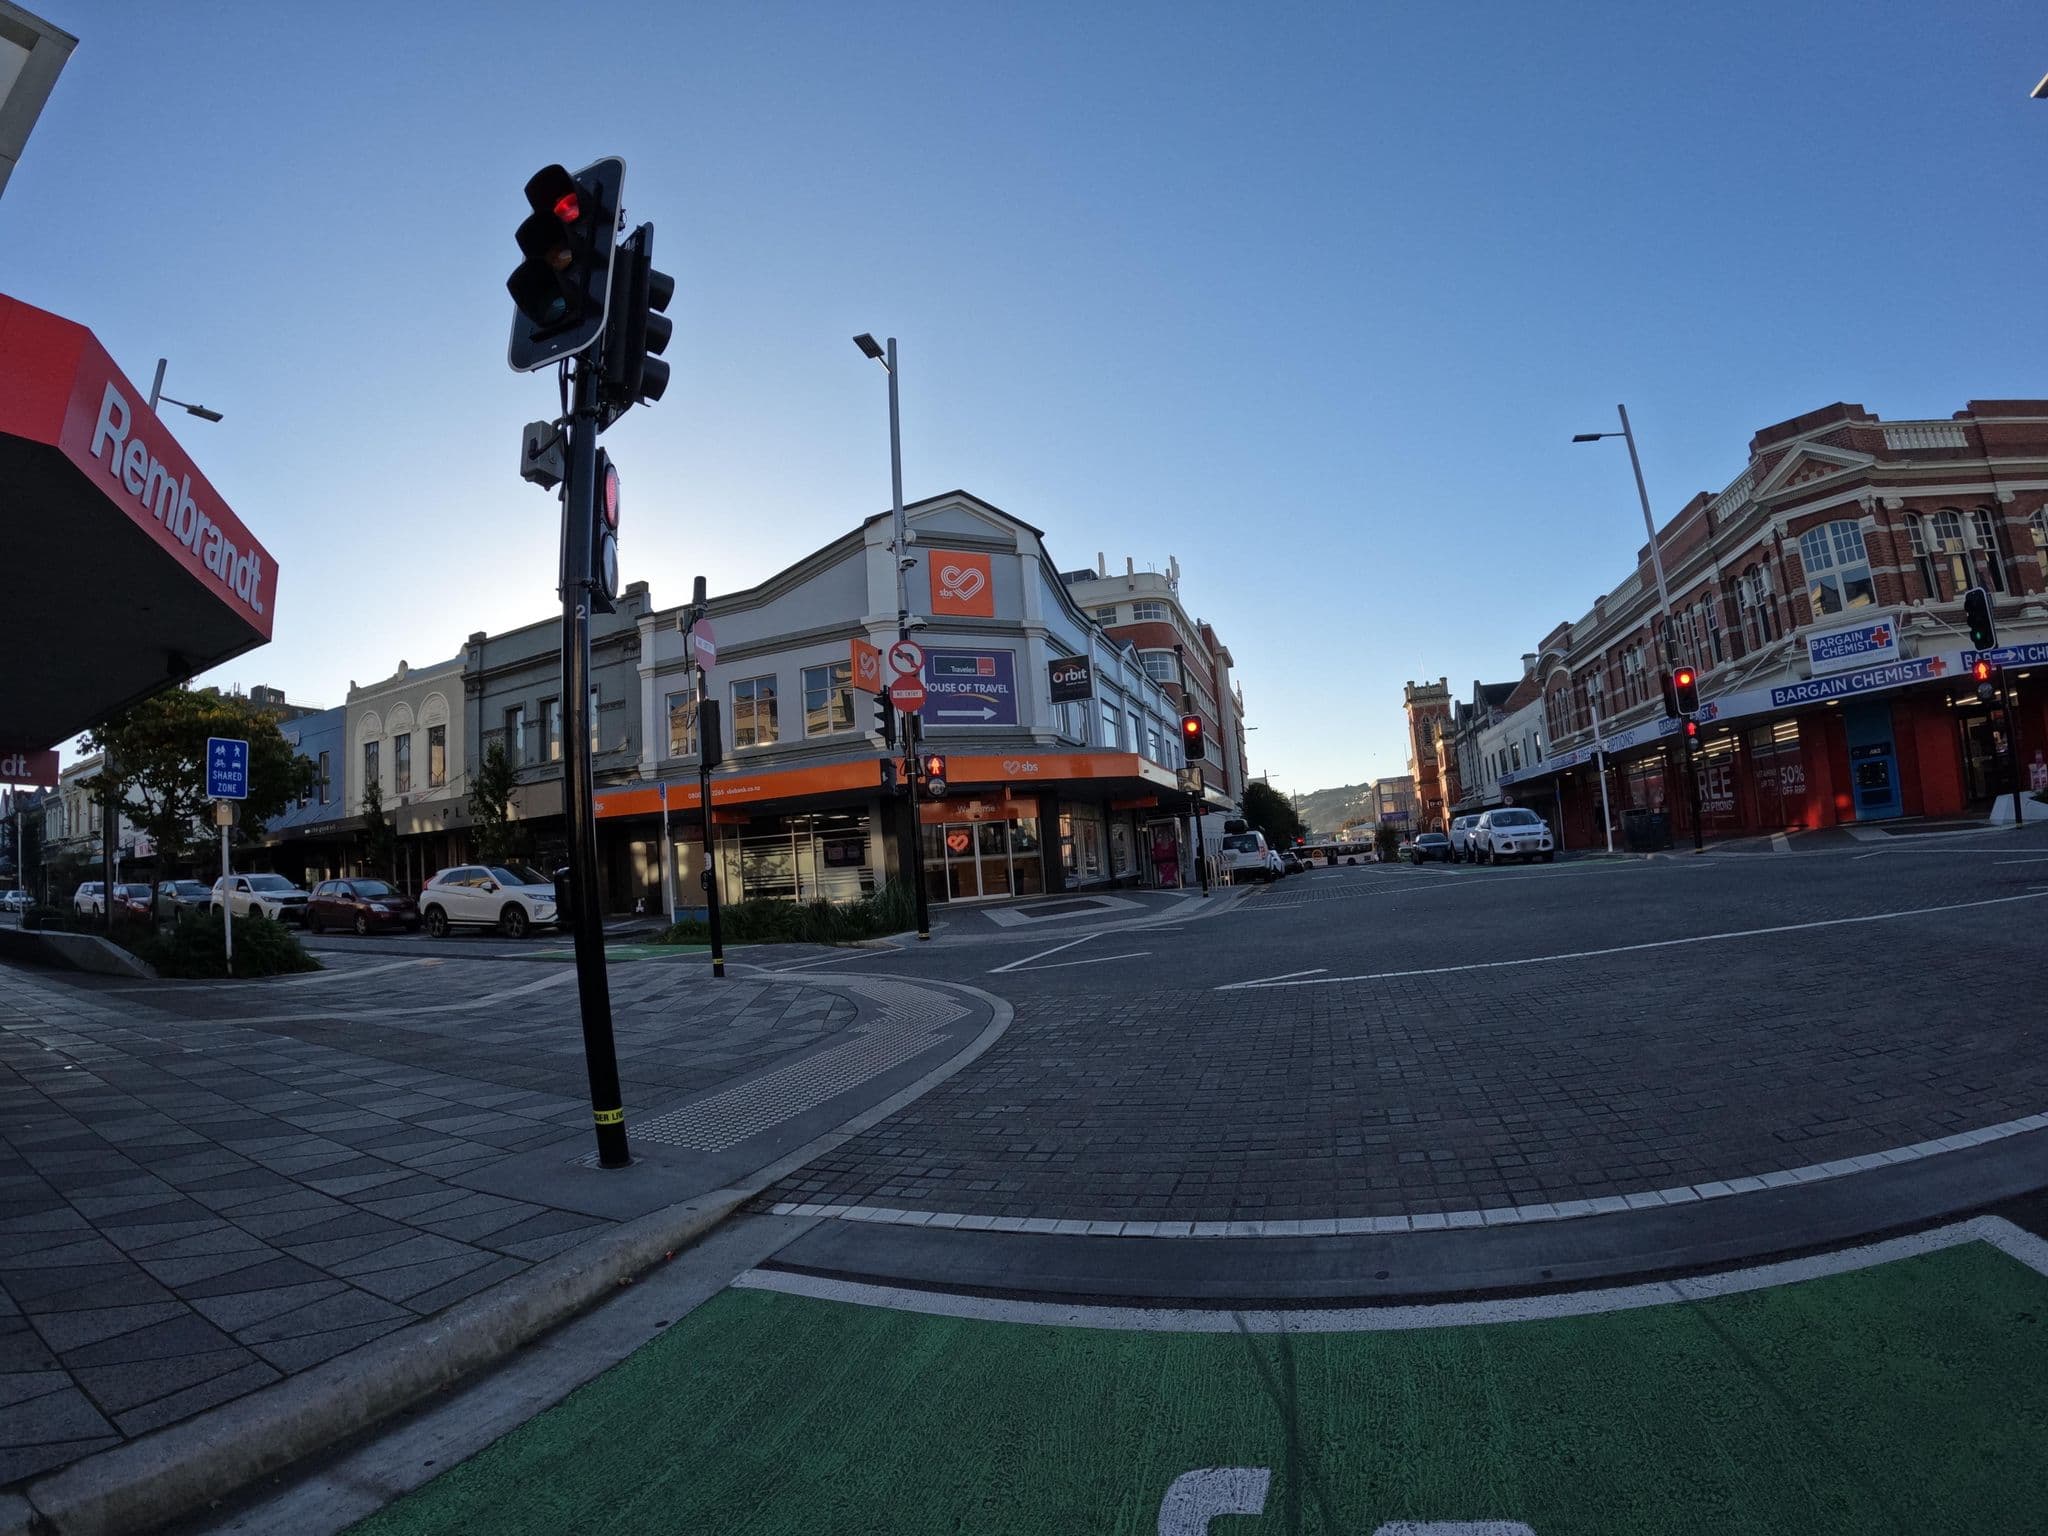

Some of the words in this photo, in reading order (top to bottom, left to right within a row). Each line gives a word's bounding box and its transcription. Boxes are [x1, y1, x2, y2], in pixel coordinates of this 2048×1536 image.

[576, 604, 586, 619] 2
[1811, 631, 1864, 650] BARGAIN
[1821, 640, 1871, 658] CHEMIST
[950, 665, 976, 674] Travelex
[958, 683, 972, 692] OF
[974, 684, 1008, 694] TRAVEL
[1775, 679, 1847, 704] BARGAIN
[1852, 663, 1922, 689] CHEMIST
[1021, 760, 1038, 772] sbs
[212, 770, 243, 781] SHARED
[1780, 764, 1805, 785] 50%
[217, 783, 237, 793] ZONE
